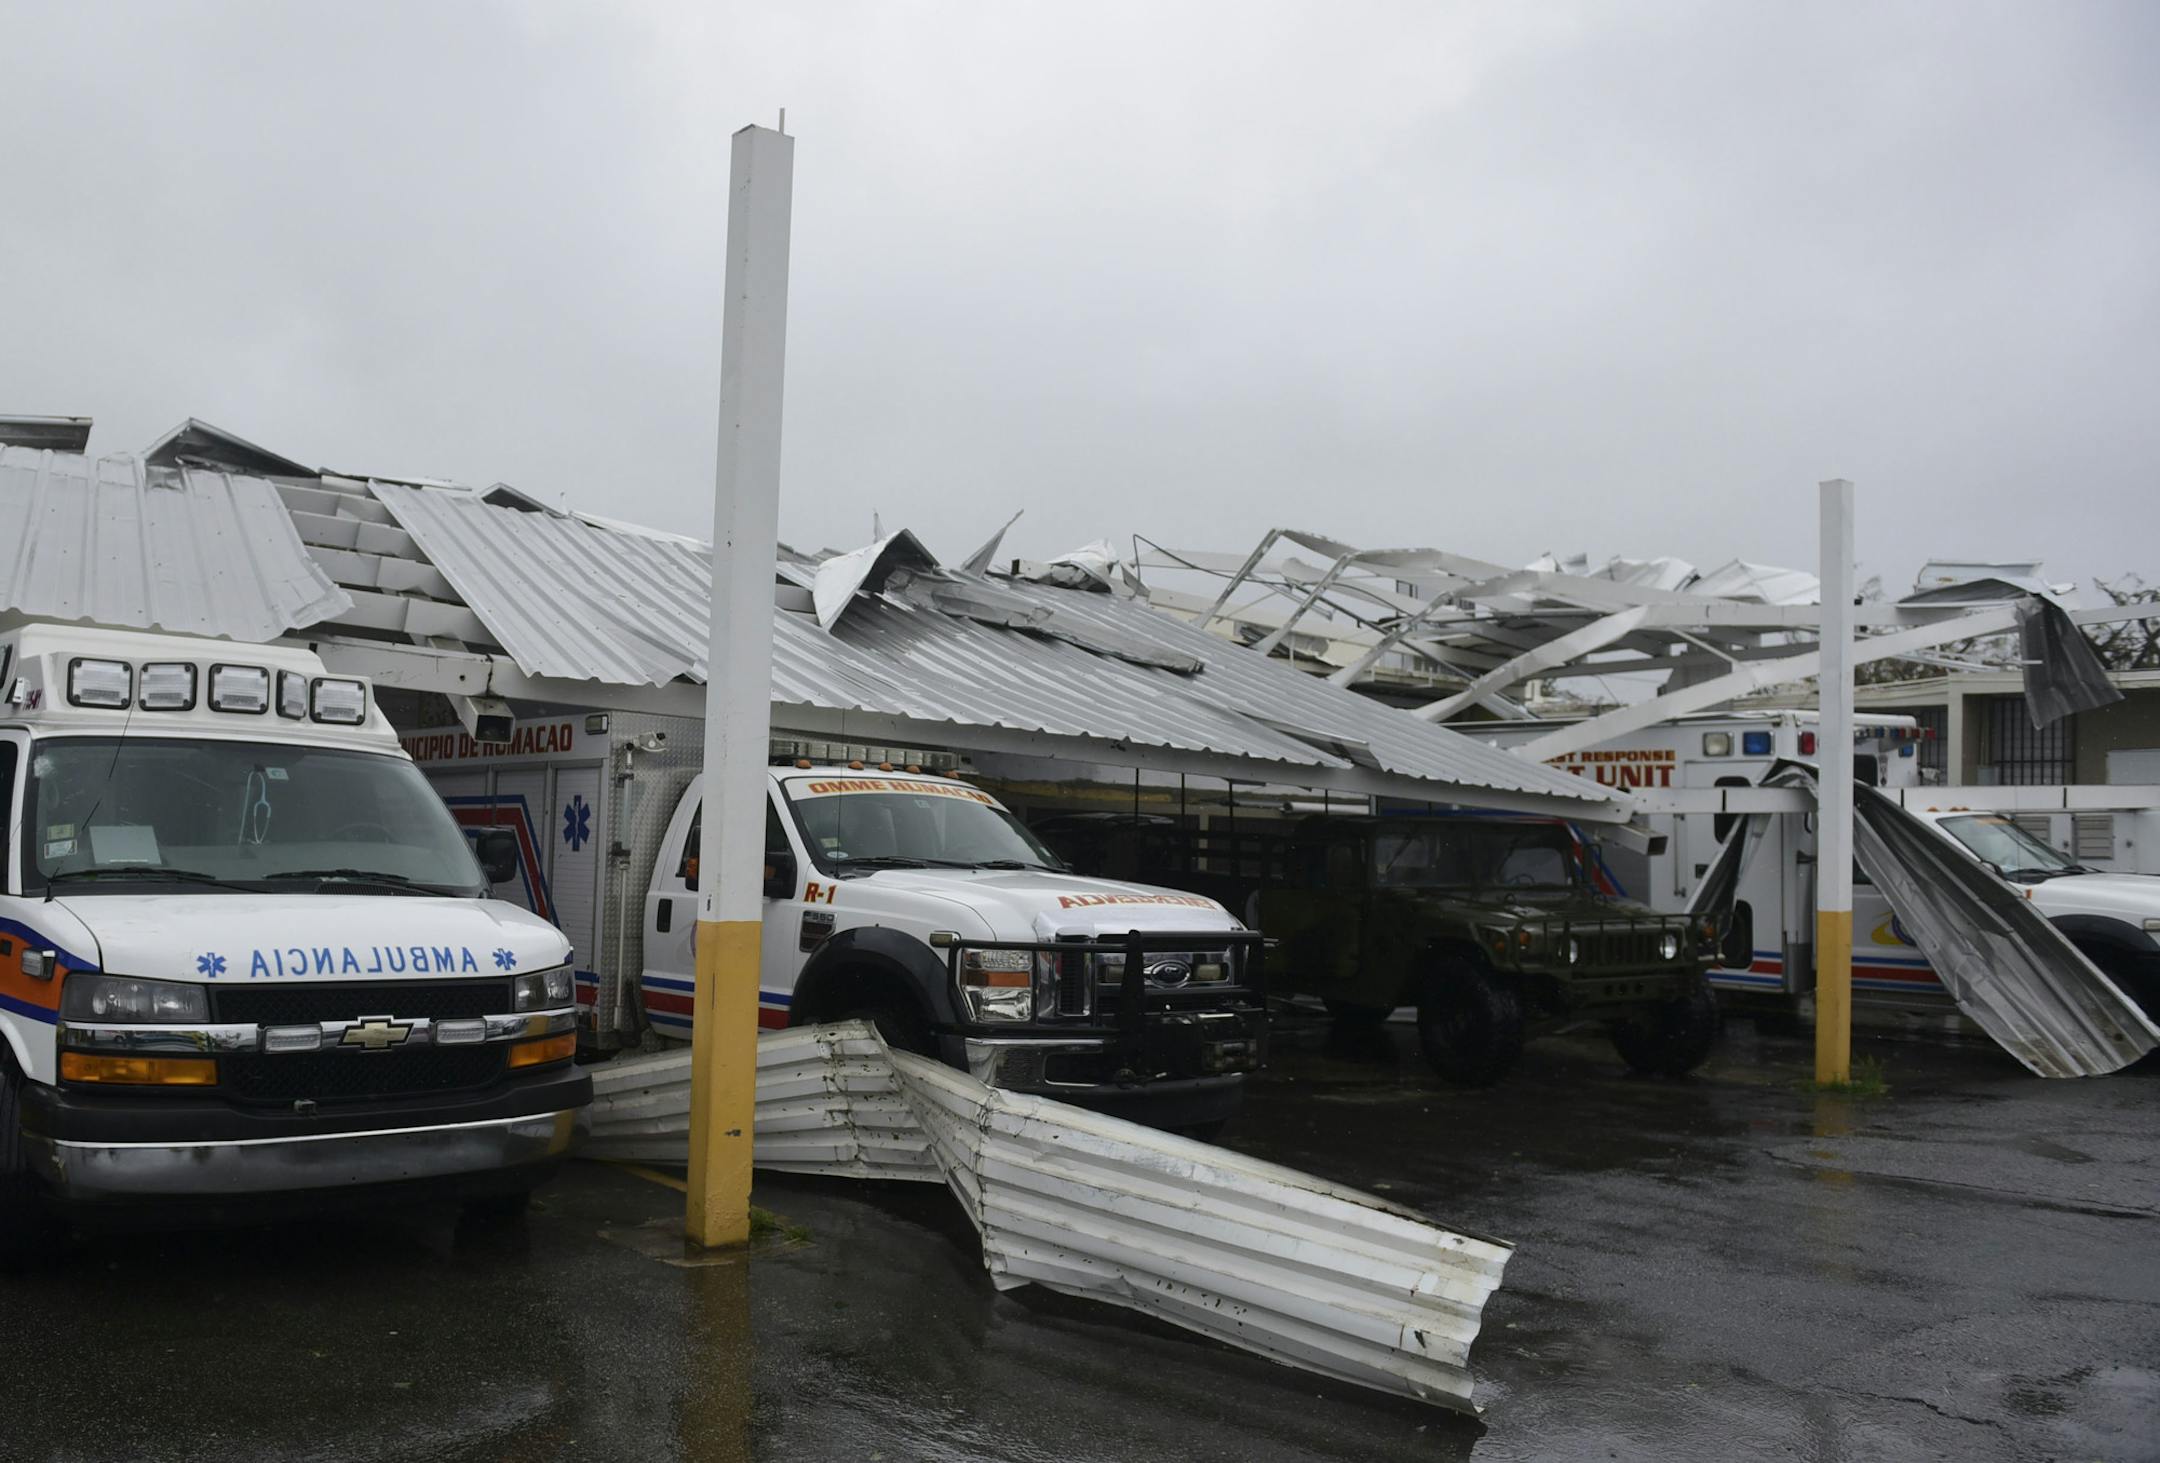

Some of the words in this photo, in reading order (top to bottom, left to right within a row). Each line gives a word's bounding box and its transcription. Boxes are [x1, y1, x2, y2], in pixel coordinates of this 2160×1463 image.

[458, 733, 480, 758] DE
[1581, 750, 1676, 763] RESPONSE
[808, 780, 885, 794] OMME
[1596, 764, 1676, 788] UNIT
[804, 882, 837, 904] R-1
